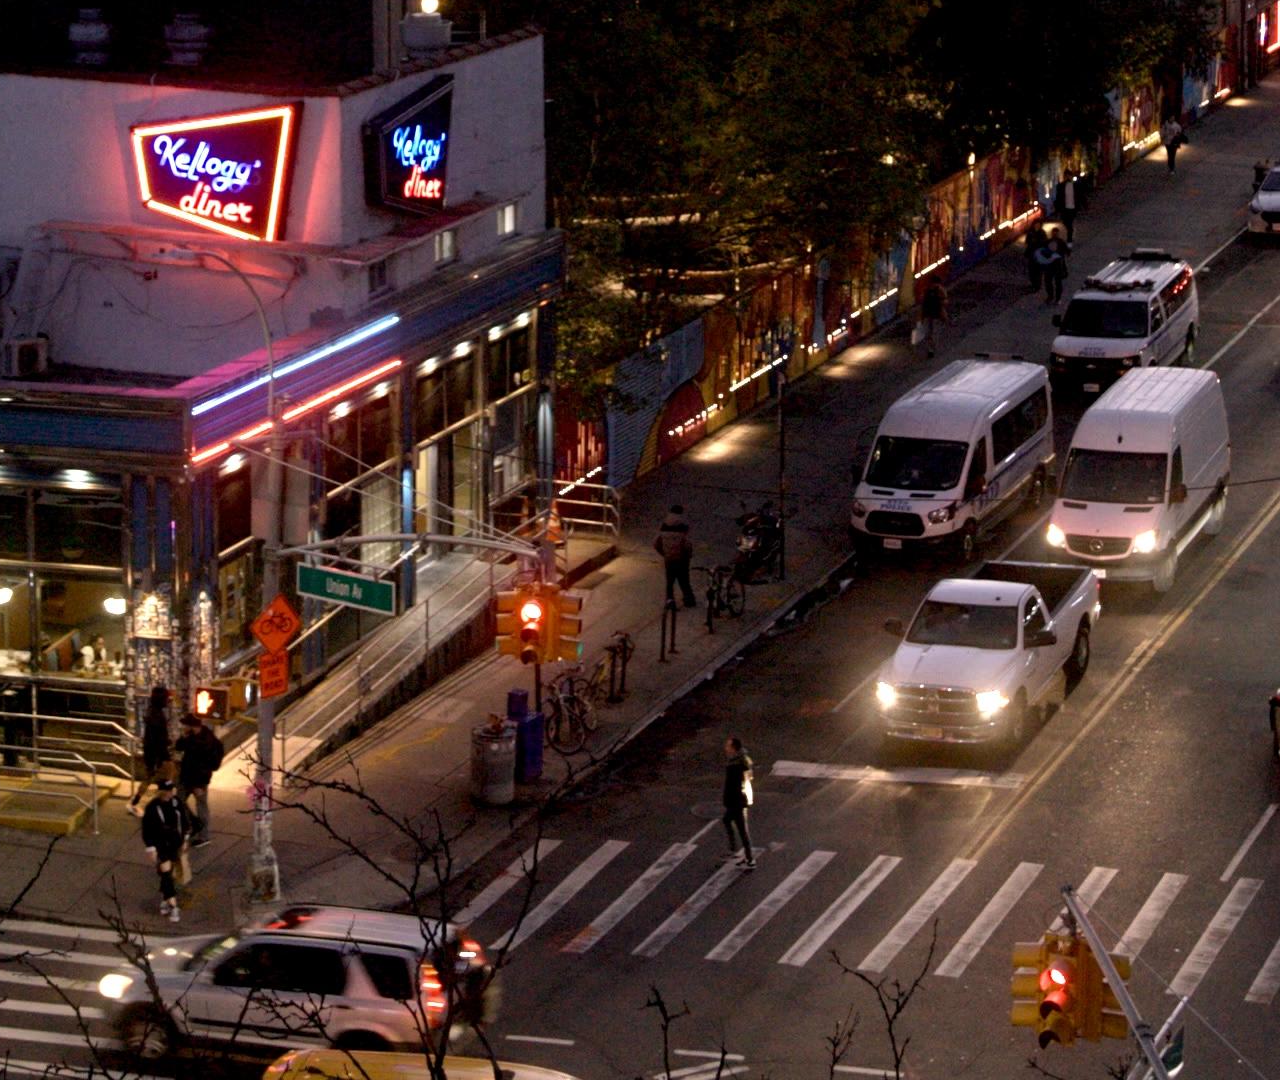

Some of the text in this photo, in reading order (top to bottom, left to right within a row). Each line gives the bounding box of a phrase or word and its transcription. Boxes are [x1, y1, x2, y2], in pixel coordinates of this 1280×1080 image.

[404, 164, 442, 199] diner
[179, 181, 254, 224] diner
[326, 577, 350, 597] Union
[270, 669, 280, 678] THE
[264, 679, 284, 691] ROAD
